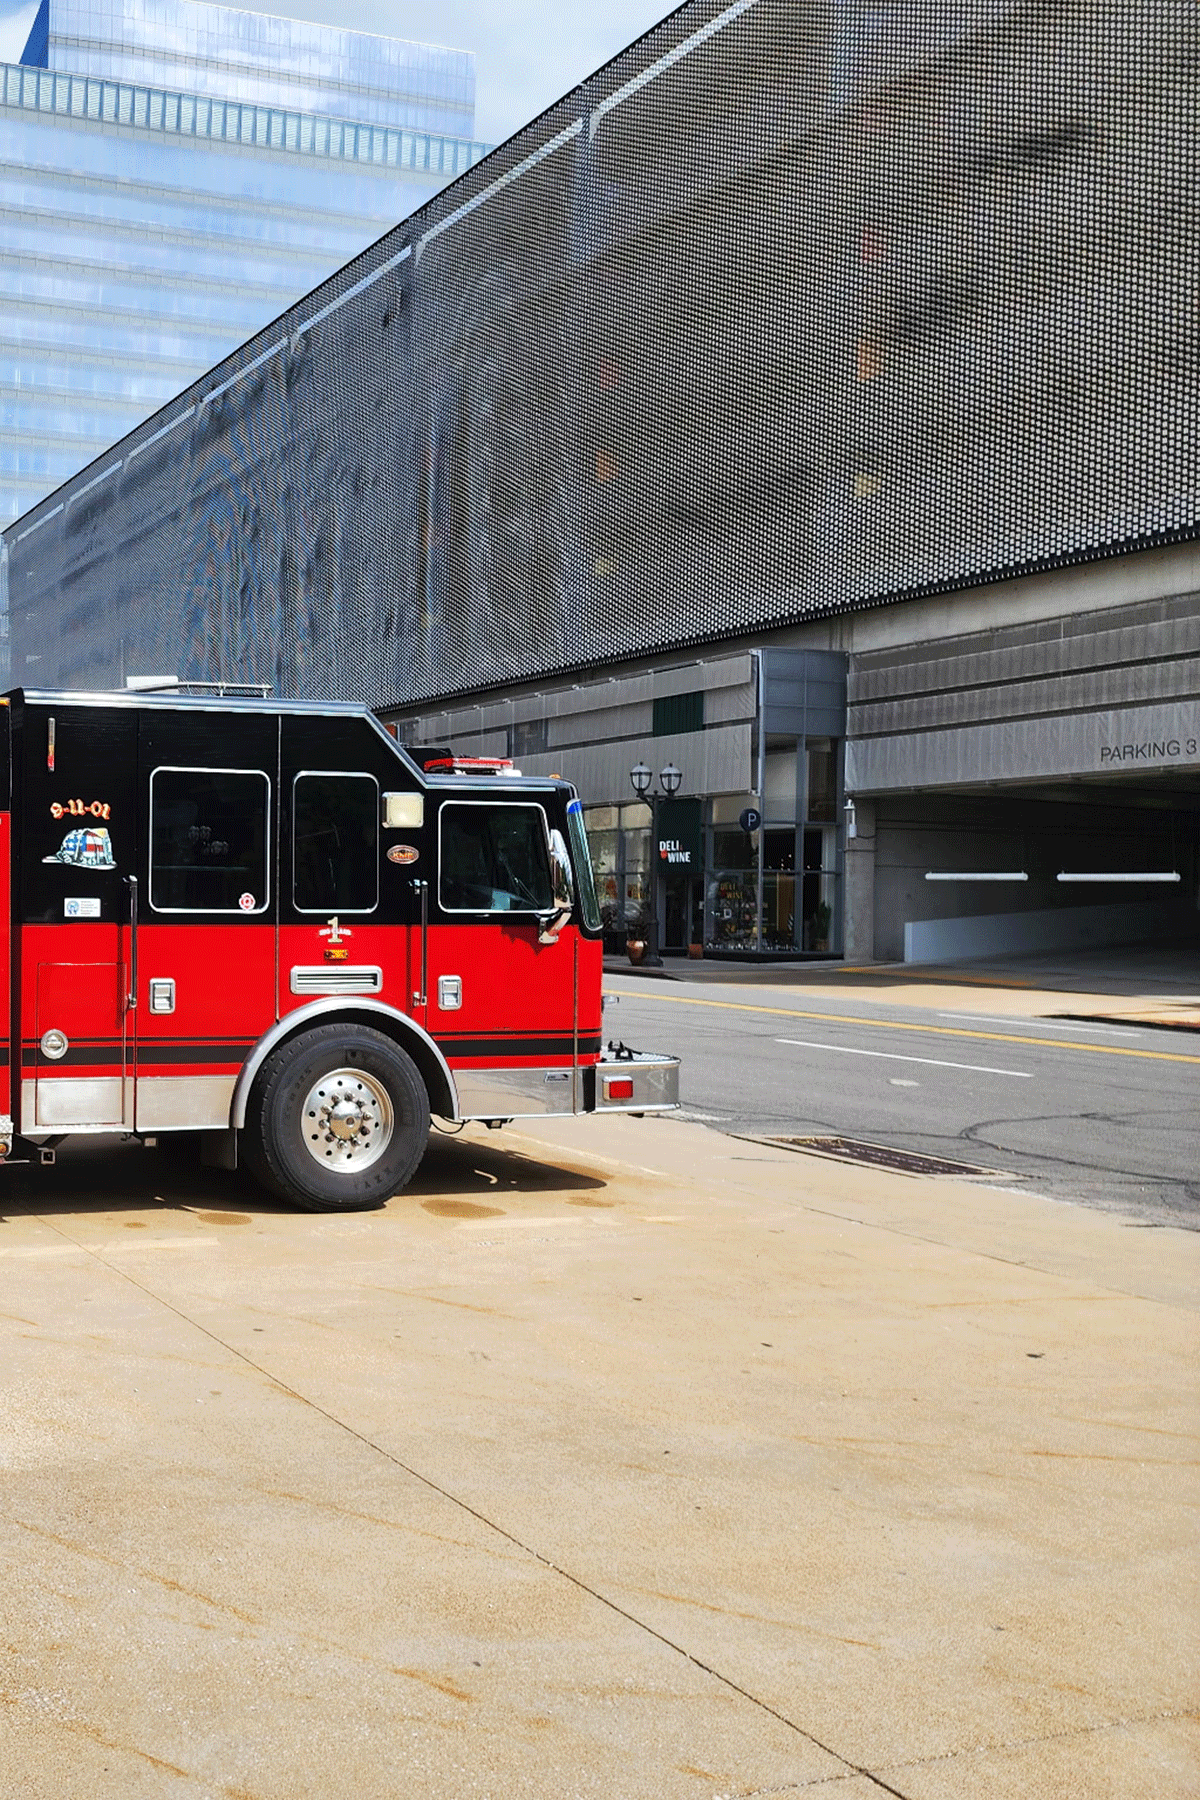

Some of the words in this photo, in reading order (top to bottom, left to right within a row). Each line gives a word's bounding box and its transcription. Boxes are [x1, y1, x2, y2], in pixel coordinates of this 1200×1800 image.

[1100, 740, 1180, 762] PARKING
[1186, 738, 1197, 755] 3
[50, 798, 111, 820] 9-11-01
[748, 812, 757, 827] P
[659, 840, 680, 851] DELI
[667, 851, 691, 863] WINE
[327, 916, 343, 943] 1
